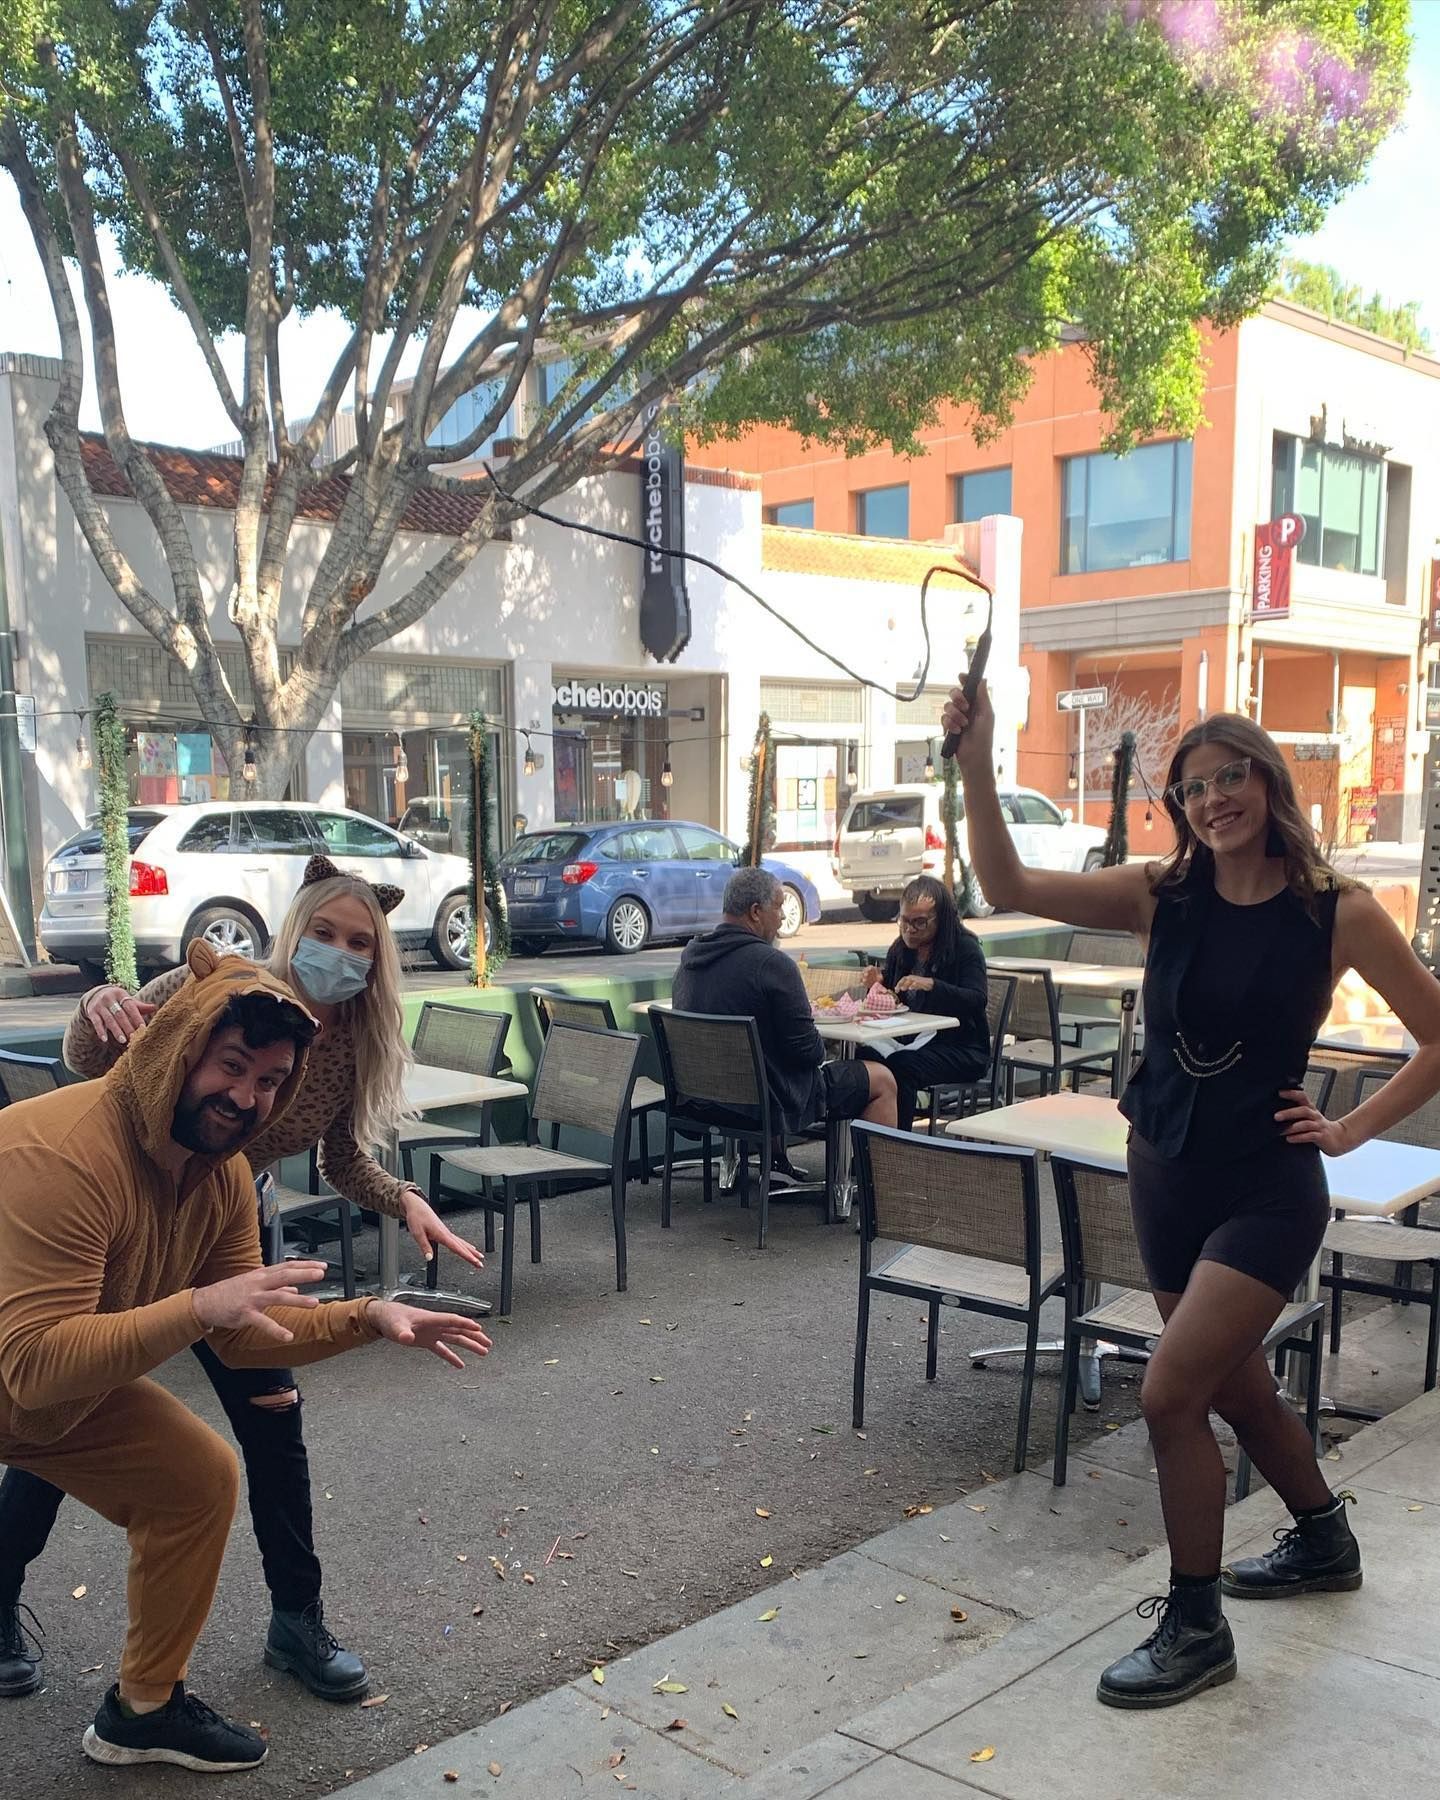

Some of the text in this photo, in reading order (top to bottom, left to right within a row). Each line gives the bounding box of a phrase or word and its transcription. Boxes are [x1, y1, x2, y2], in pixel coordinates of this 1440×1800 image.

[1281, 518, 1296, 543] P
[1257, 545, 1272, 609] PARKING
[624, 709, 661, 717] PARIS
